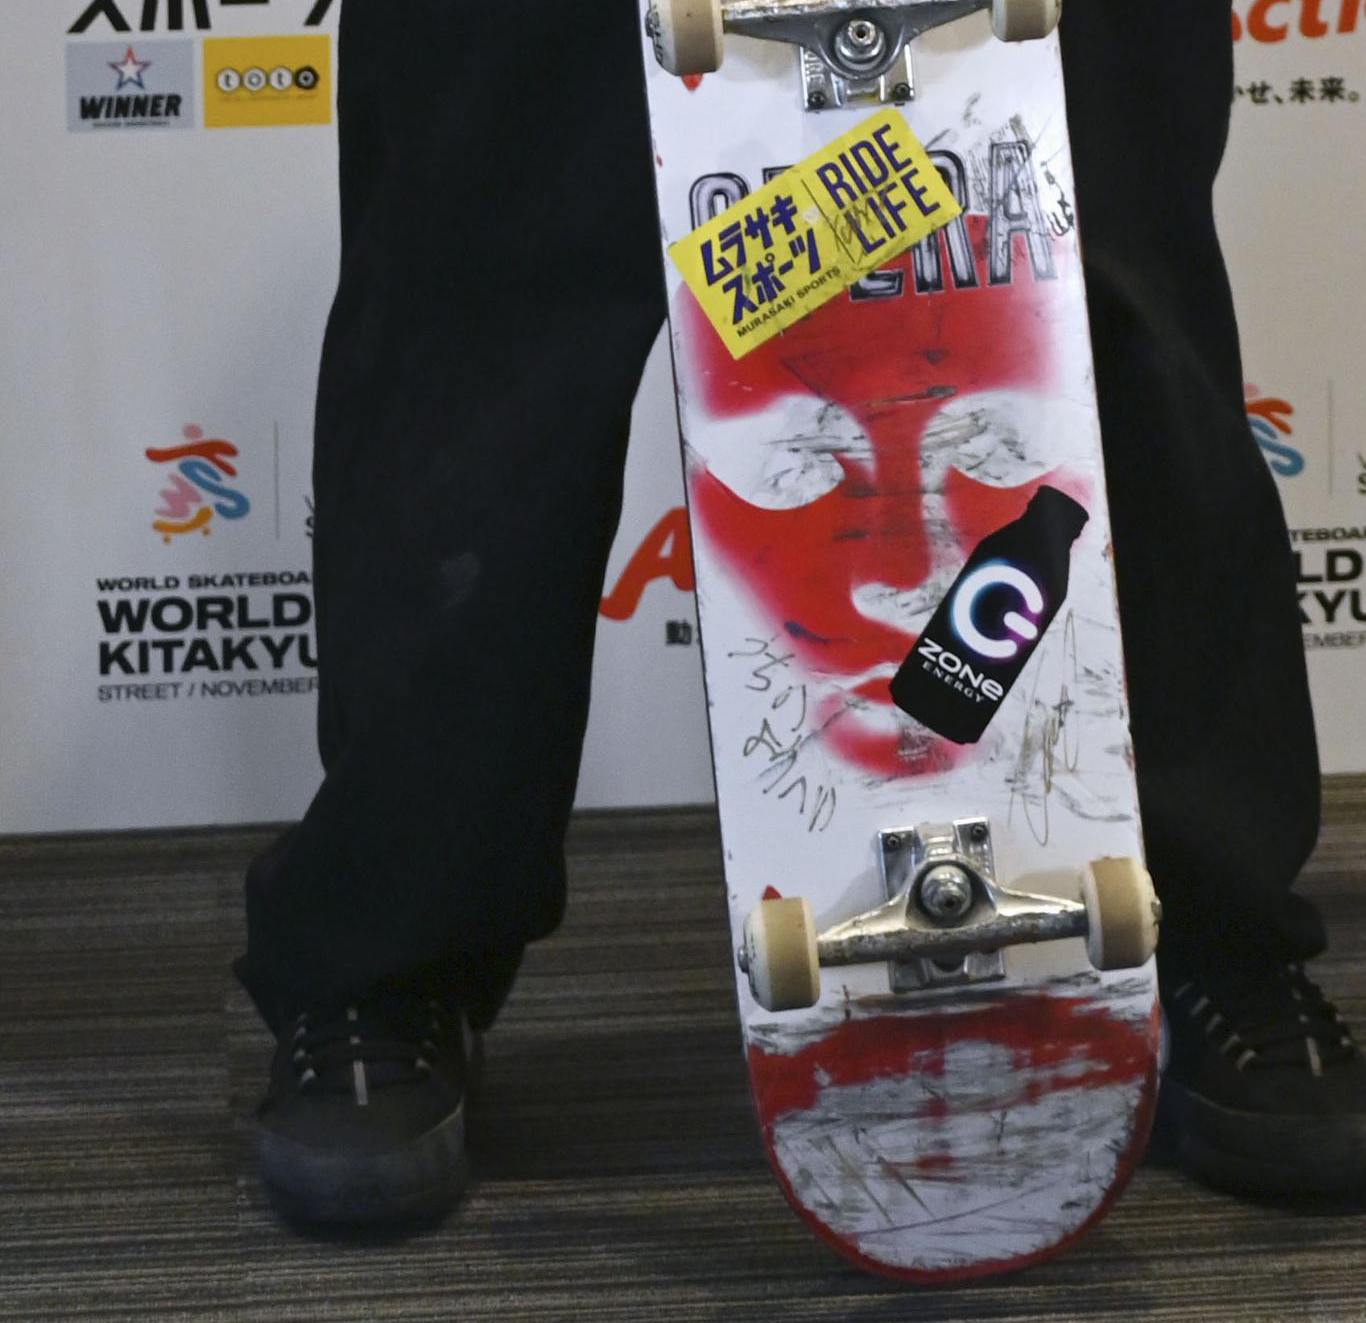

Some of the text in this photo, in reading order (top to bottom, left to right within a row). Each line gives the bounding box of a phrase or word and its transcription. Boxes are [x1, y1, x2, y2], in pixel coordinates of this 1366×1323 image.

[79, 93, 182, 121] WINNER
[816, 123, 913, 210] RIDE
[844, 167, 941, 255] LIFE
[700, 195, 798, 287] ムラサキ
[721, 227, 822, 326] スポーツ
[736, 266, 841, 337] MURASAKI SPORTS
[97, 571, 311, 592] WORLD SKATEBOA
[97, 593, 312, 634] WORLD
[99, 634, 319, 676] KITAKYU
[98, 683, 182, 702] STREET
[922, 660, 985, 703] ENERGY
